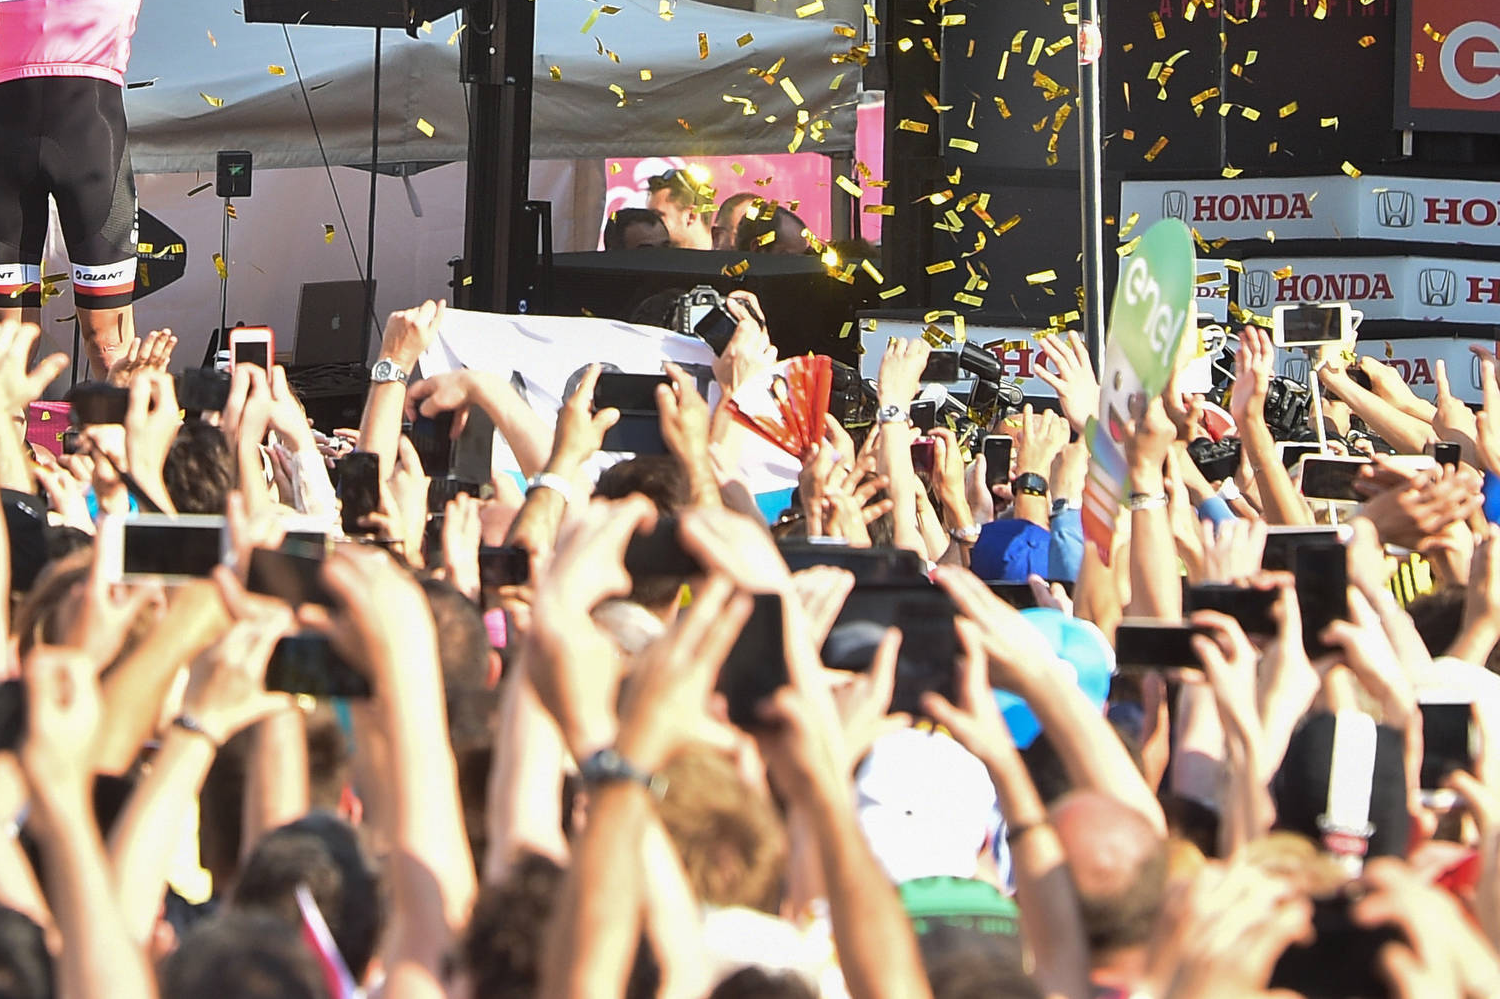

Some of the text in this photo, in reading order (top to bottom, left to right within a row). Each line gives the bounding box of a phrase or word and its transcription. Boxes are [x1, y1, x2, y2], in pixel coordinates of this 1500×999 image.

[1192, 192, 1313, 222] HONDA
[1423, 197, 1500, 226] HO
[82, 270, 124, 281] GIANT
[1275, 273, 1395, 301] HONDA
[1125, 257, 1186, 368] enel
